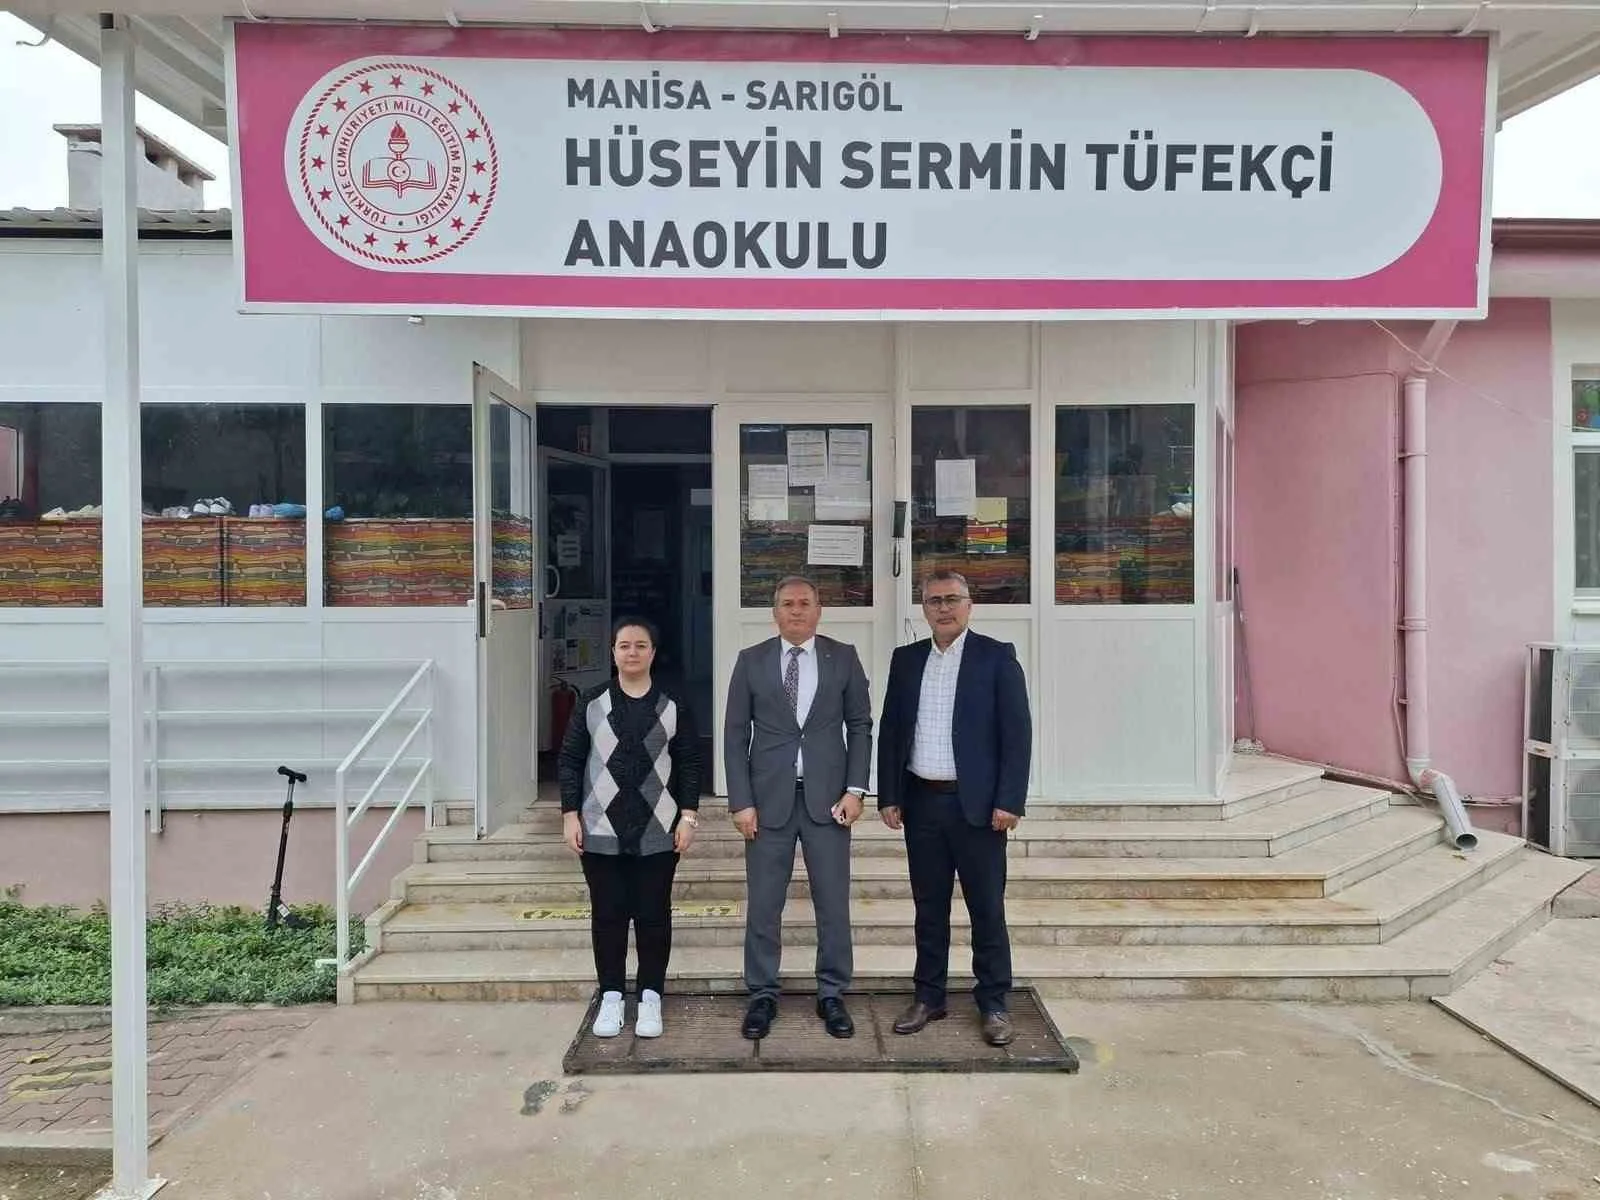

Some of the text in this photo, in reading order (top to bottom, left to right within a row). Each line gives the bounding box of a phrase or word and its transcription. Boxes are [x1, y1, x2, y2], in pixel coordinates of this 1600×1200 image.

[567, 70, 903, 112] MANİSA - SARIGÖL
[337, 99, 389, 178] CUMHURİYETİ
[565, 124, 1334, 199] HÜSEYİN SERMİN TÜFEKÇİ
[341, 181, 387, 226] TÜRKİYE
[415, 165, 462, 225] BAKANLIĞI
[564, 219, 887, 270] ANAOKULU
